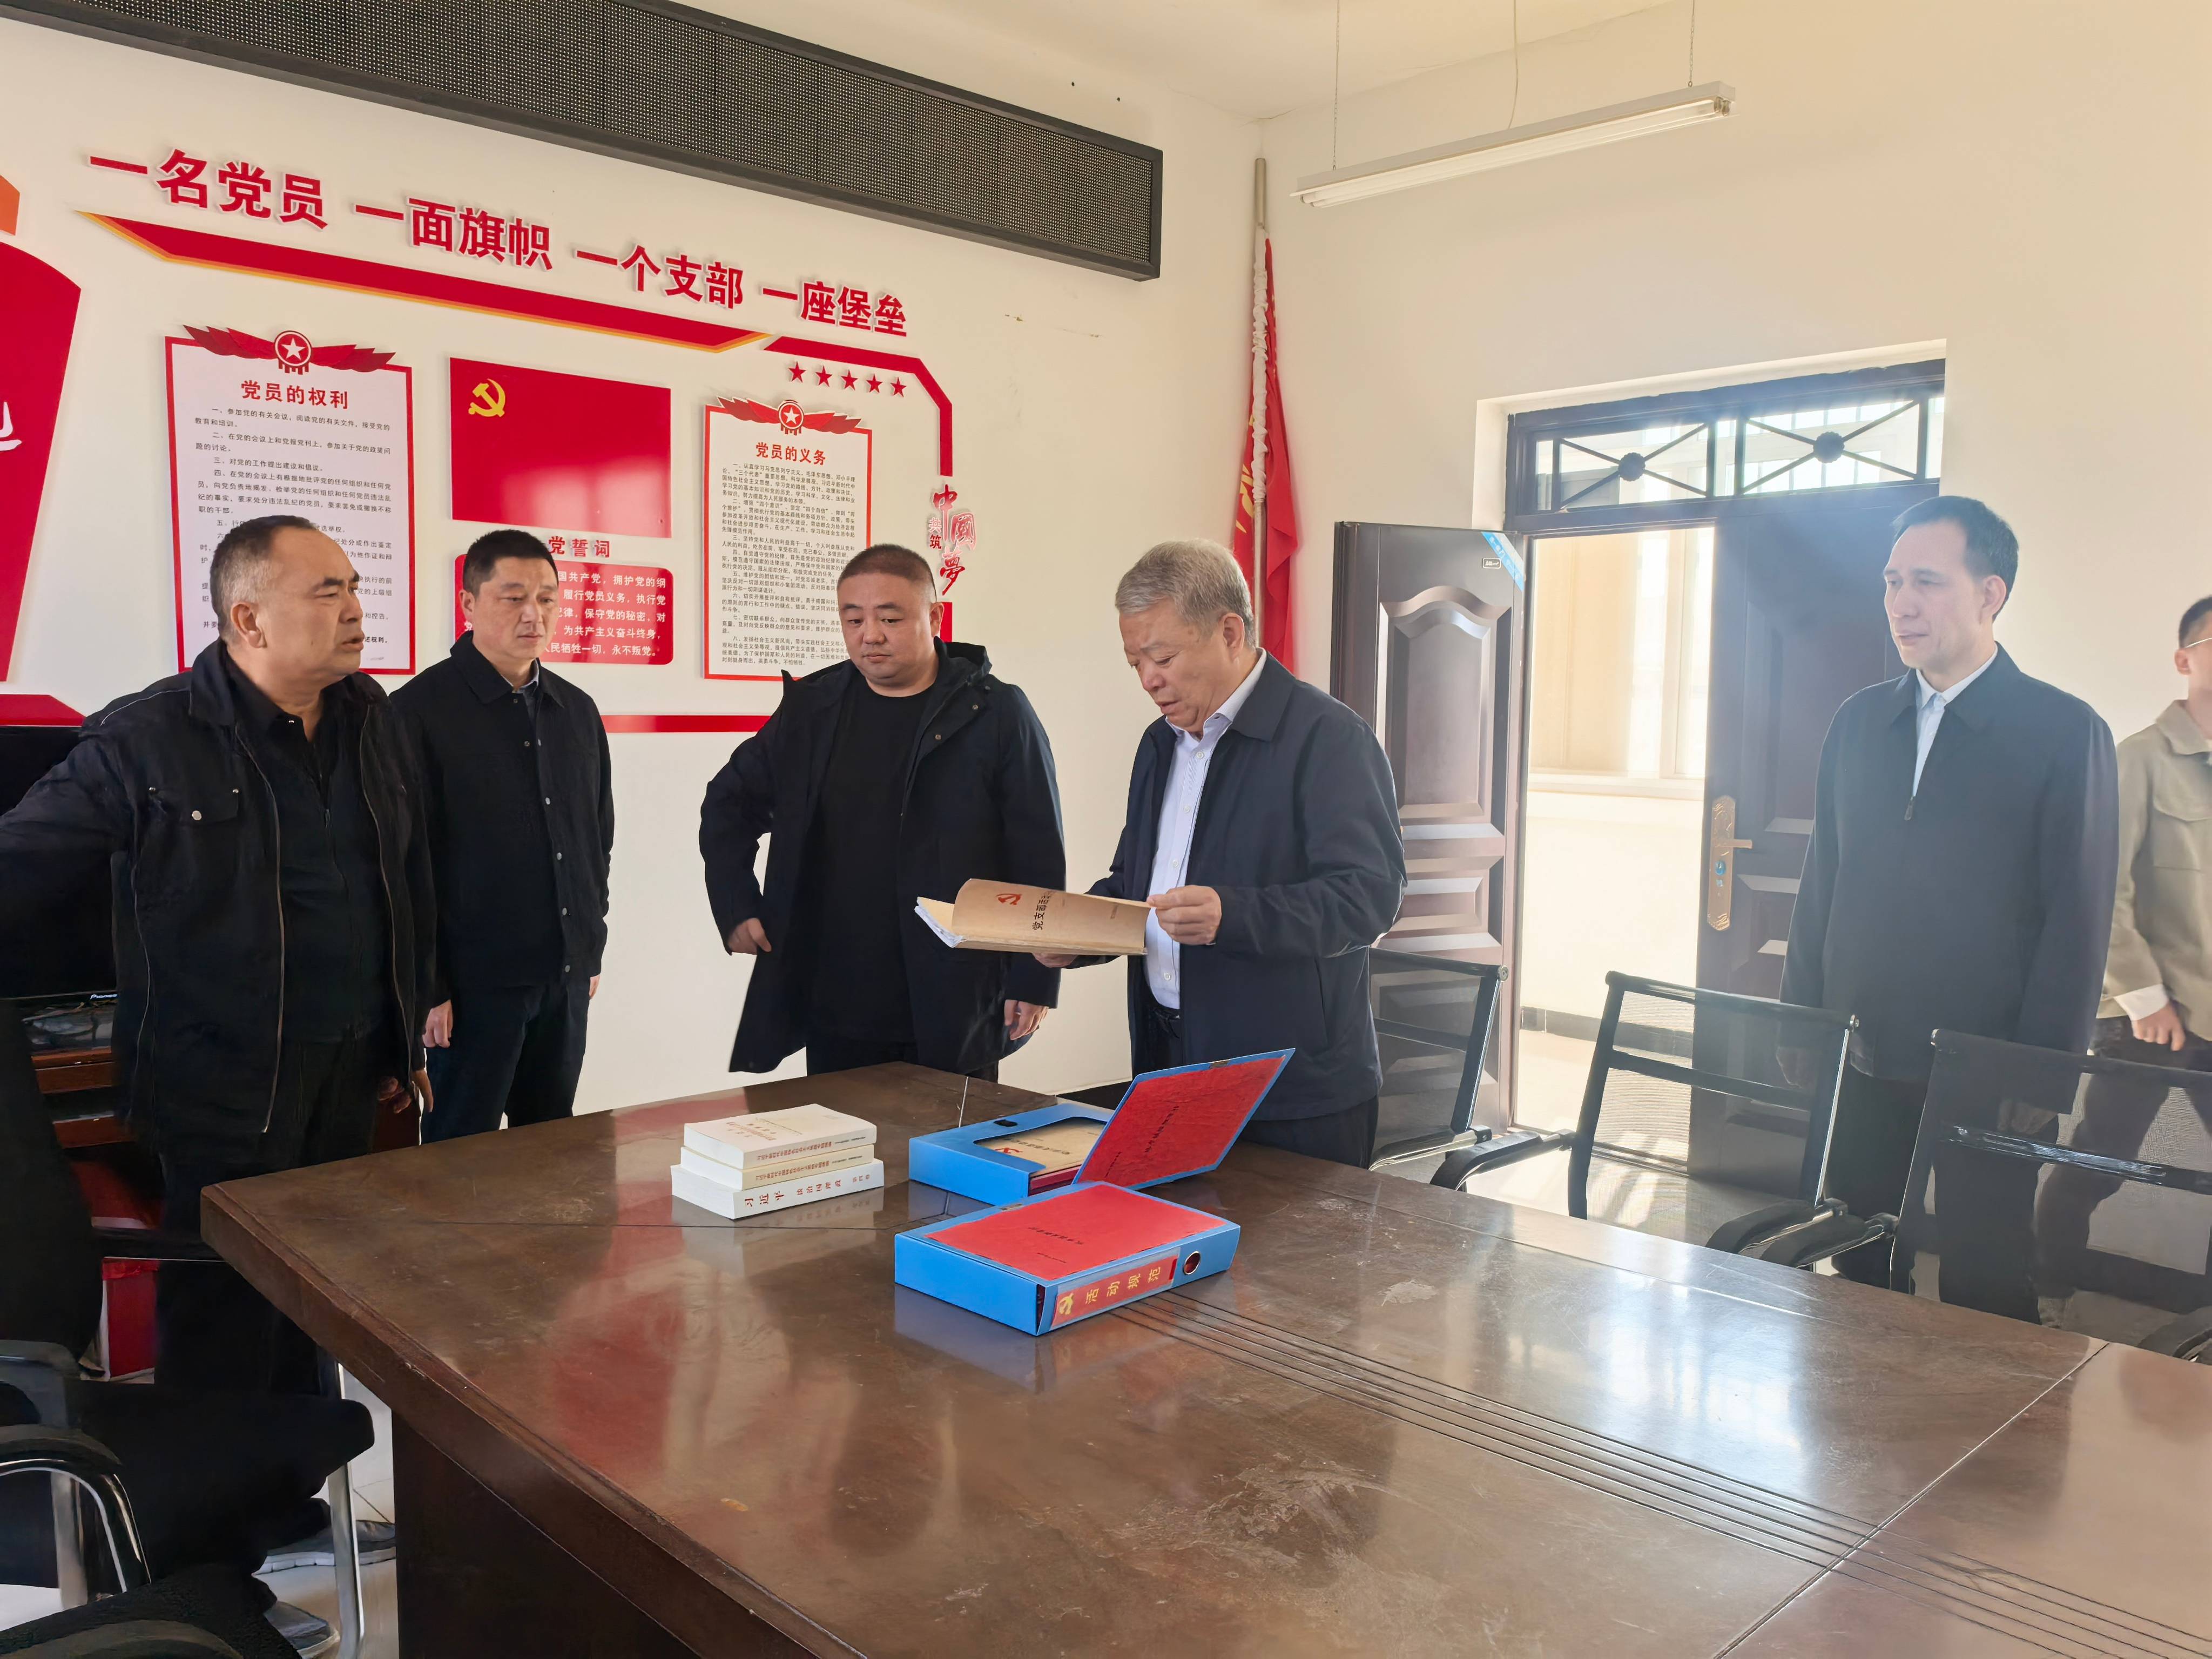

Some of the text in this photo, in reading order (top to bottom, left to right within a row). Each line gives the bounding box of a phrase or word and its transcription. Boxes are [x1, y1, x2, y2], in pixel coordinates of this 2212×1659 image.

[90, 149, 908, 338] 一名党员 一面旗帜 一个支部 一座堡垒
[241, 380, 349, 409] 党员的权利
[756, 442, 826, 466] 党员的义务
[548, 535, 611, 558] 党誓词
[928, 517, 942, 550] 共筑
[563, 589, 666, 605] 履行党员义务，执行党
[744, 1190, 785, 1208] 习近平
[797, 1179, 841, 1196] 谈治国理政
[1085, 1266, 1161, 1305] 活动规范
